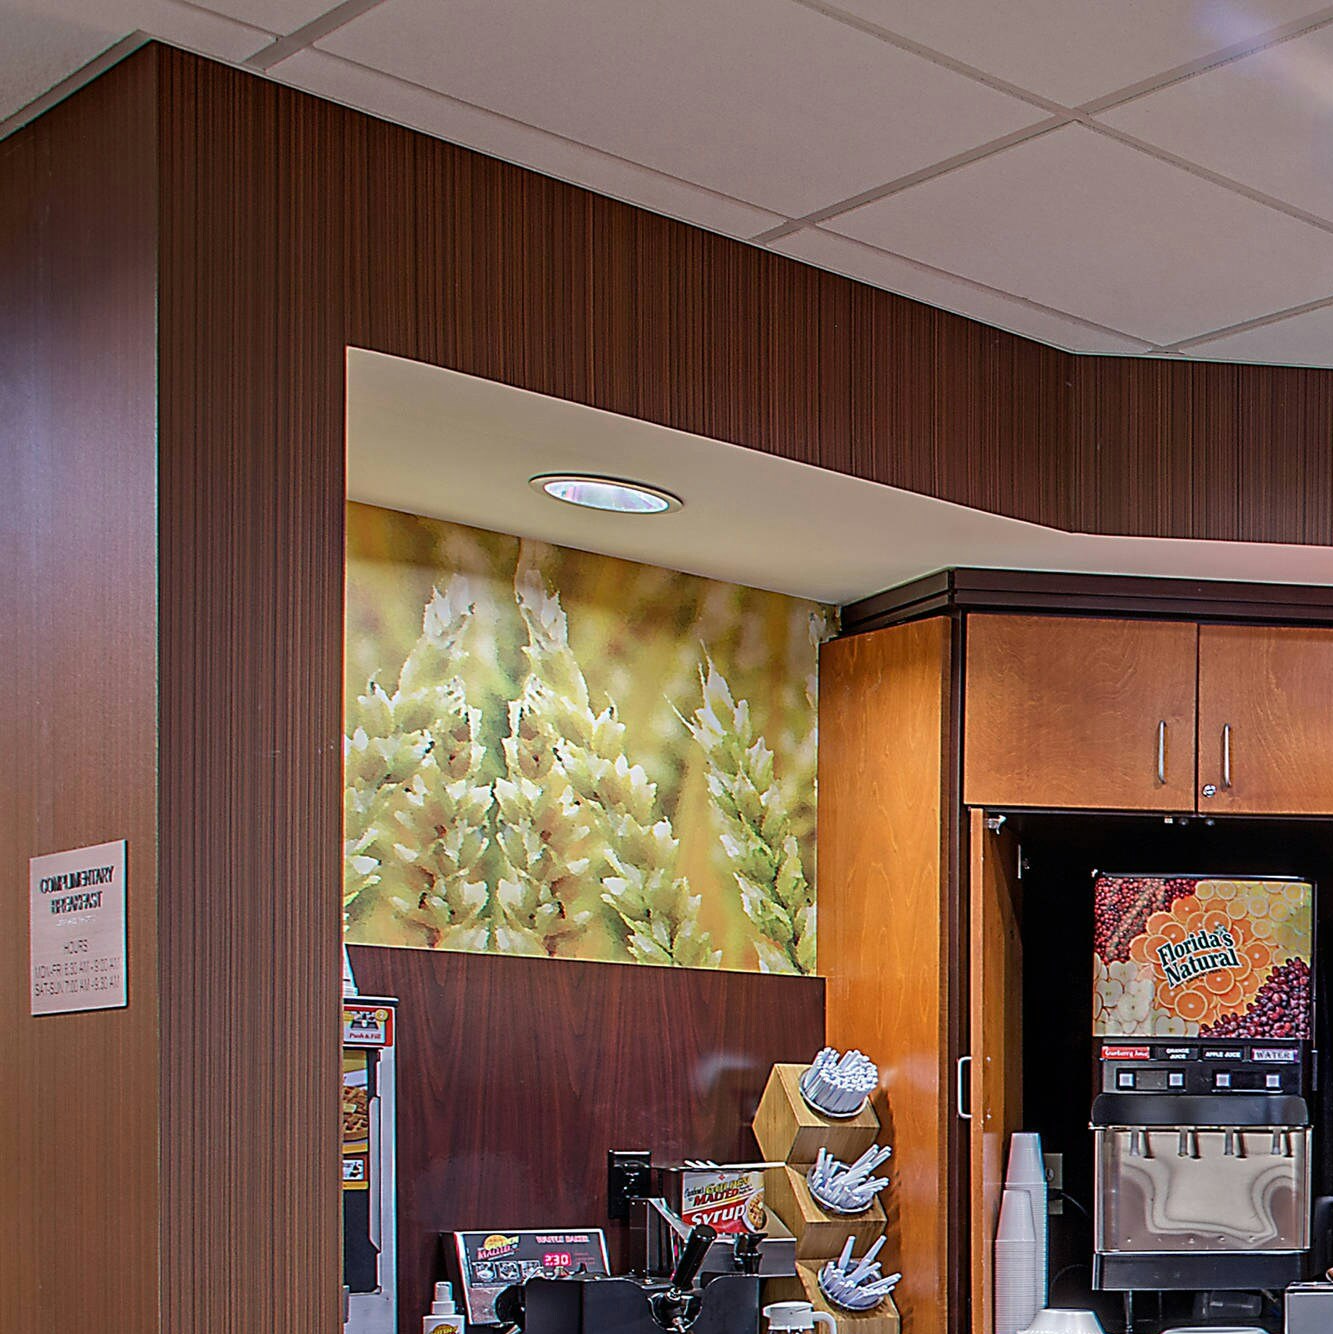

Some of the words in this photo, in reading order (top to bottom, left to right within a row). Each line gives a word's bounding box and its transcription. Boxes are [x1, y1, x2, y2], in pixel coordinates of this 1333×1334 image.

[40, 865, 114, 893] COMPLIMENTARY
[51, 891, 103, 914] BREAKFAST
[1157, 926, 1234, 968] Florida's
[1164, 948, 1241, 988] Natural
[1256, 1050, 1292, 1059] WATER
[693, 1188, 739, 1206] MALTED
[691, 1204, 746, 1226] Syrup
